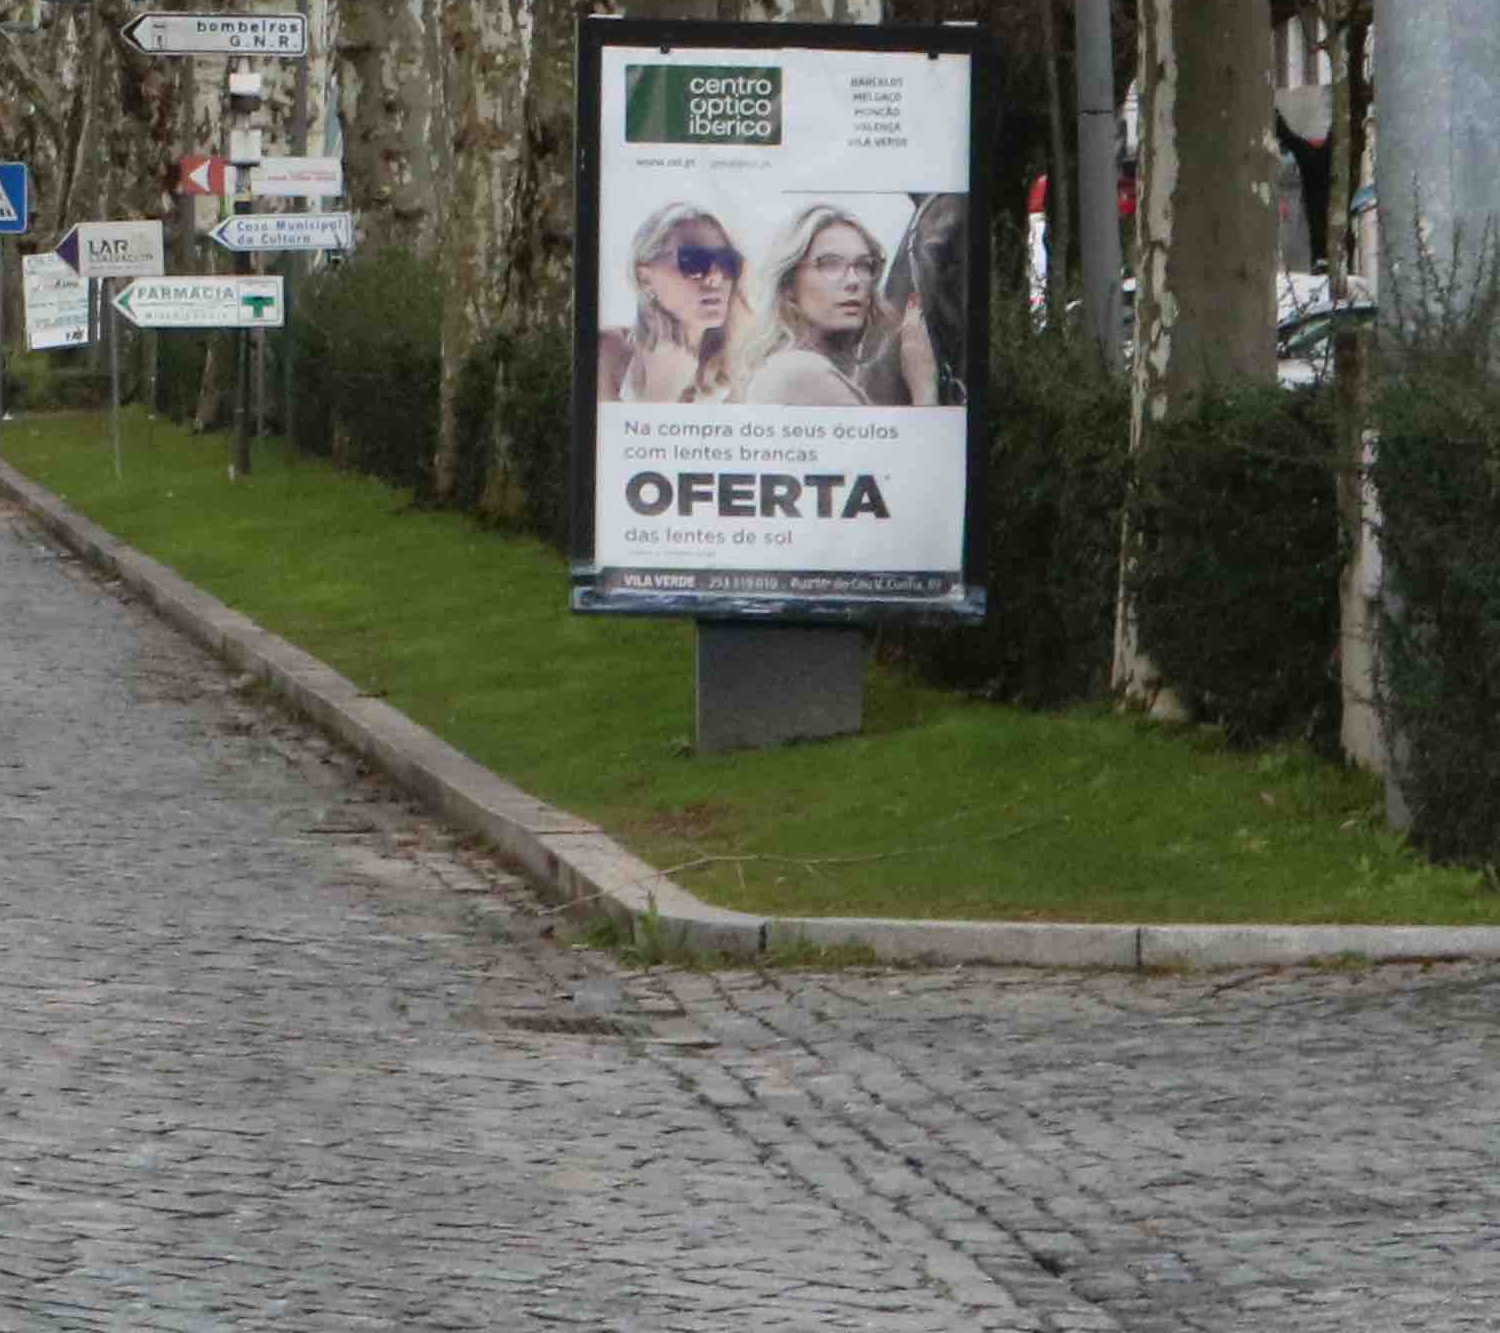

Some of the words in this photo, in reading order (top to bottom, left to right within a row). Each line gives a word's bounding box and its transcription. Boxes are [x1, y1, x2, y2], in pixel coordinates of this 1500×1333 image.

[197, 20, 298, 33] bombeiros
[689, 77, 772, 95] centro
[624, 421, 650, 438] Na
[658, 424, 733, 443] compra
[739, 422, 775, 438] dos
[781, 425, 826, 439] seus
[832, 421, 900, 440] óculos
[624, 447, 667, 460] com
[674, 445, 733, 461] lentes
[739, 445, 819, 462] brancas
[624, 527, 660, 543] das
[666, 528, 726, 544] lentes
[732, 529, 757, 545] de
[764, 530, 793, 545] sol
[623, 573, 653, 588] VILA
[654, 574, 696, 589] VERDE
